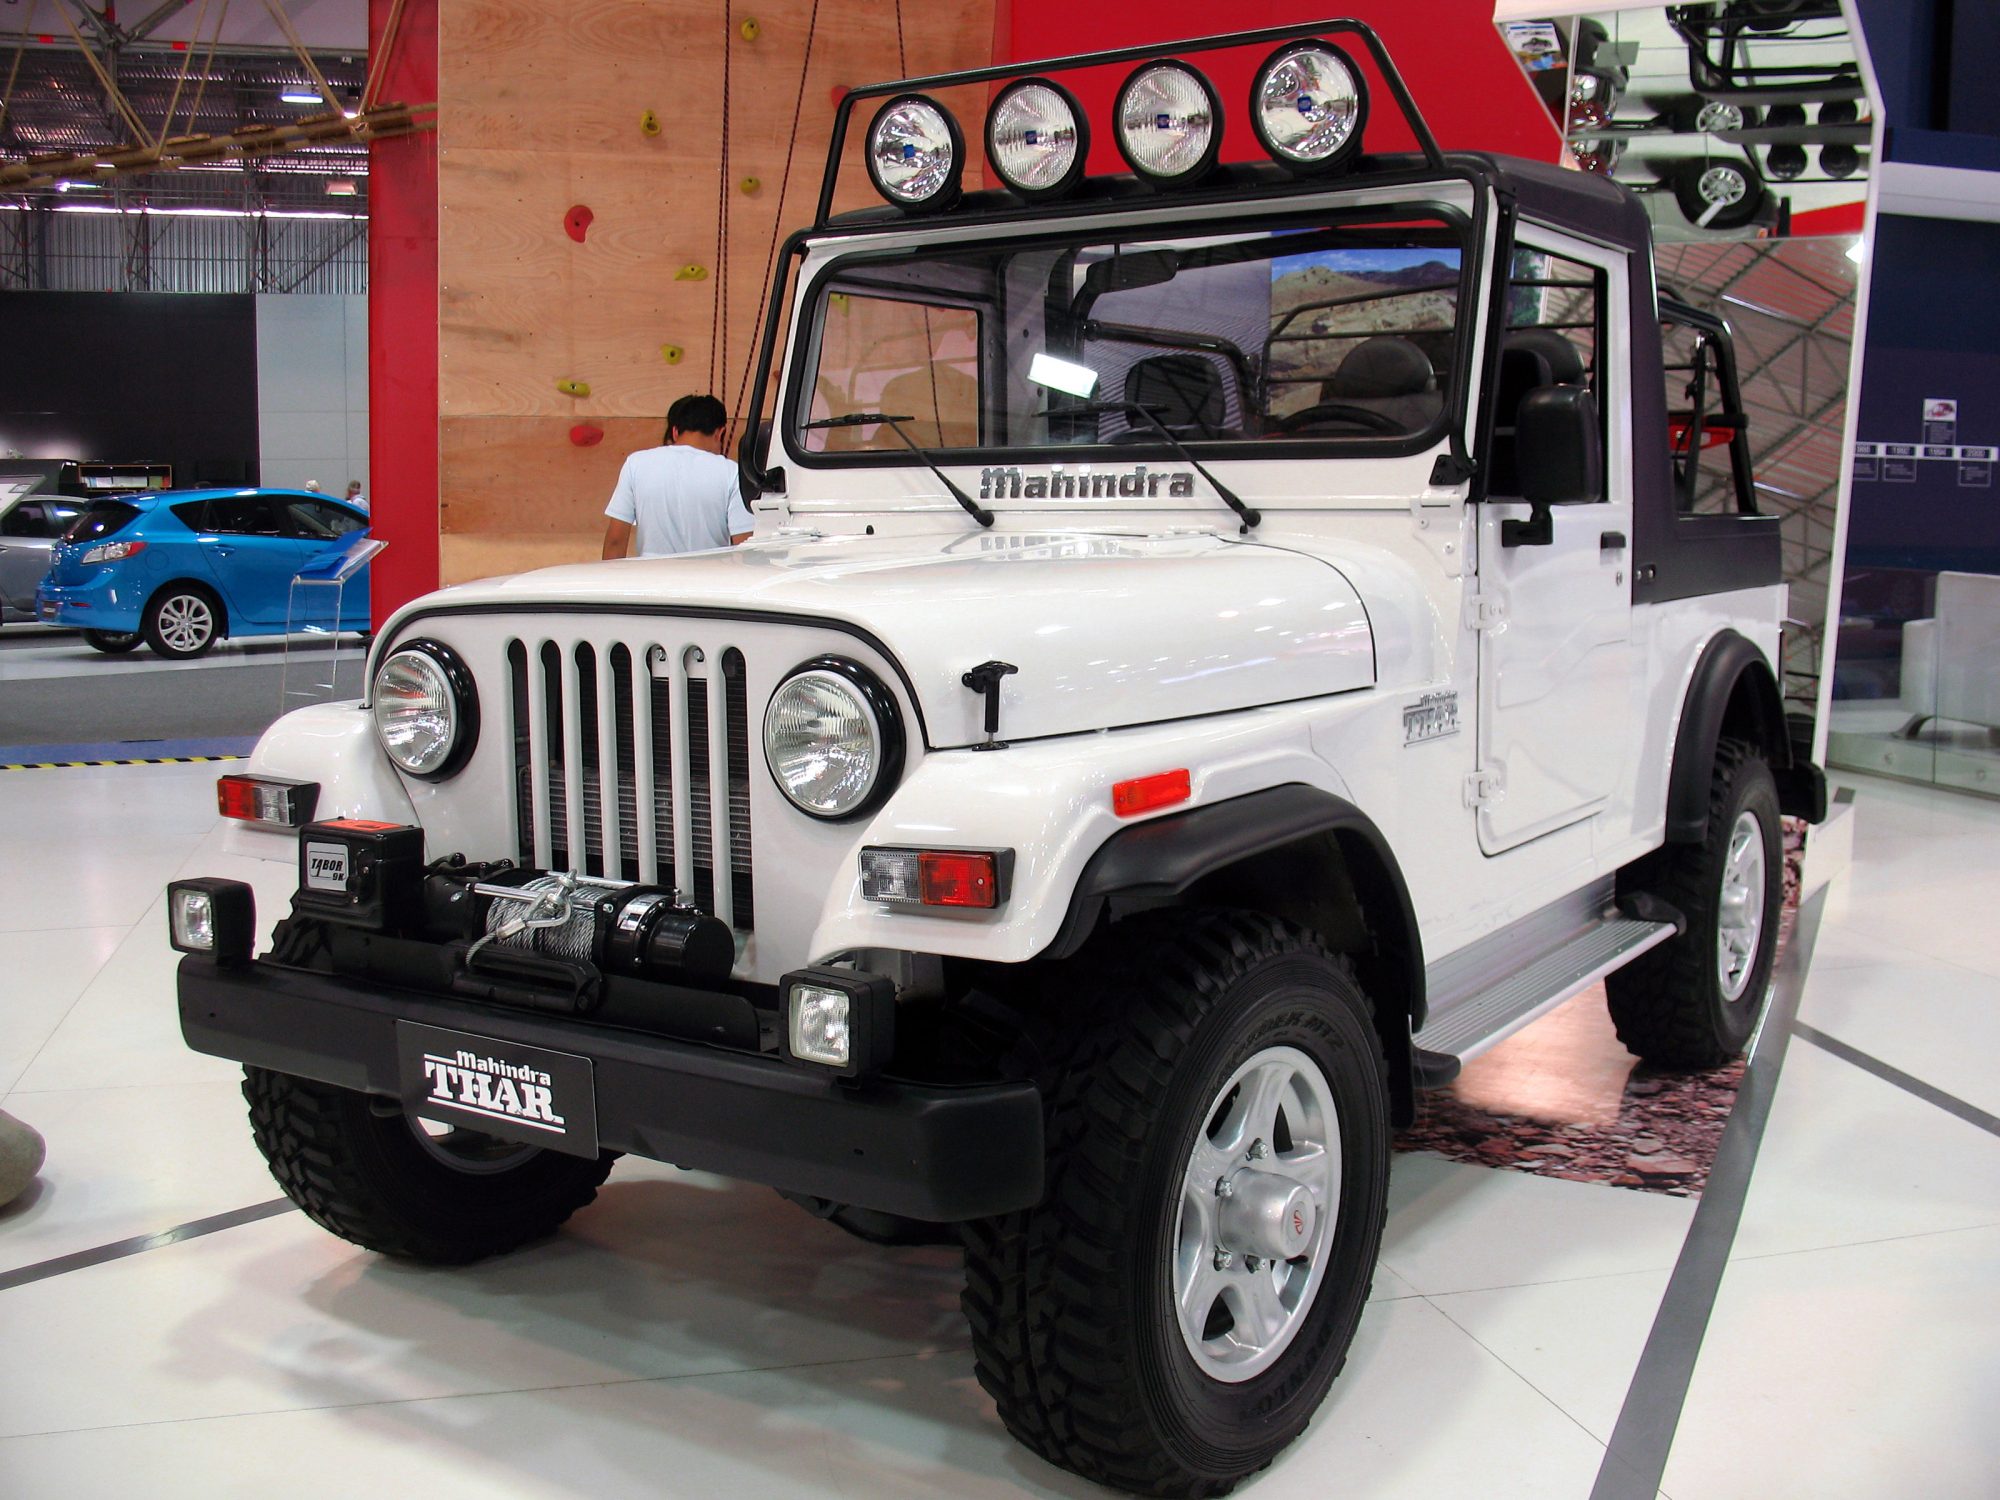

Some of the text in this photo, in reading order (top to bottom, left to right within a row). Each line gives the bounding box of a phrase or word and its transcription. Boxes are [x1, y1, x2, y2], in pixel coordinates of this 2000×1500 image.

[311, 858, 344, 877] TABOR
[332, 872, 345, 882] 9K
[424, 1060, 565, 1124] THAR
